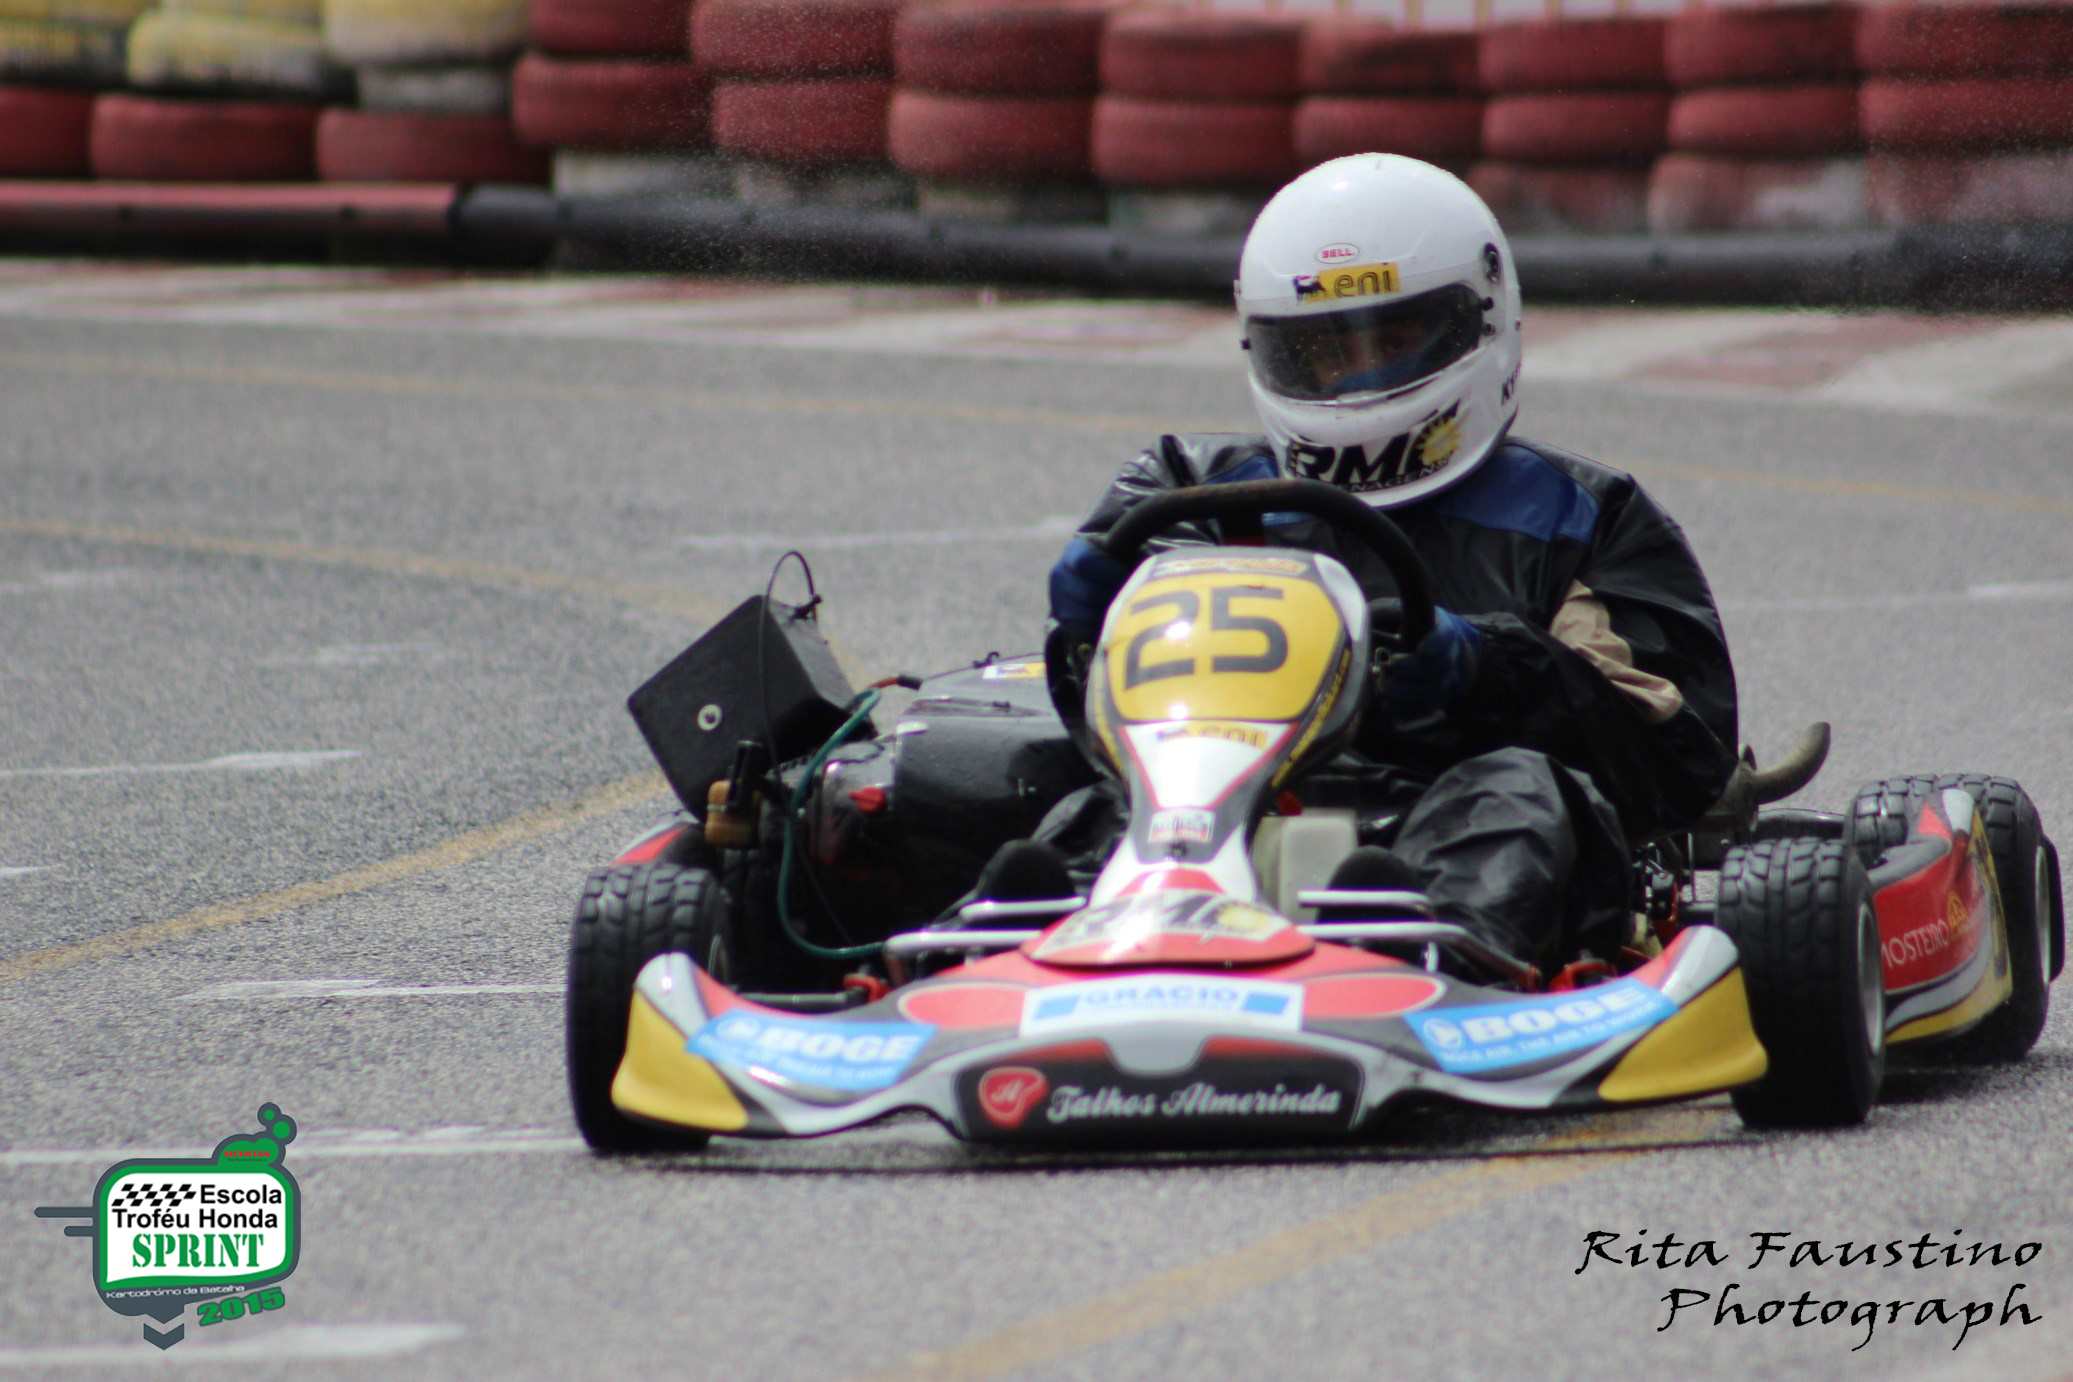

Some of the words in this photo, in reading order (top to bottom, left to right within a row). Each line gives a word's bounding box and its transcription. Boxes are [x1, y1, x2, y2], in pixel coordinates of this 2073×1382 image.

[1322, 248, 1354, 258] BELL
[1333, 270, 1391, 298] eni
[1124, 587, 1289, 692] 25
[1460, 986, 1648, 1044] BOGE
[1046, 1085, 1156, 1124] Talhos
[1161, 1081, 1342, 1115] Almerinda
